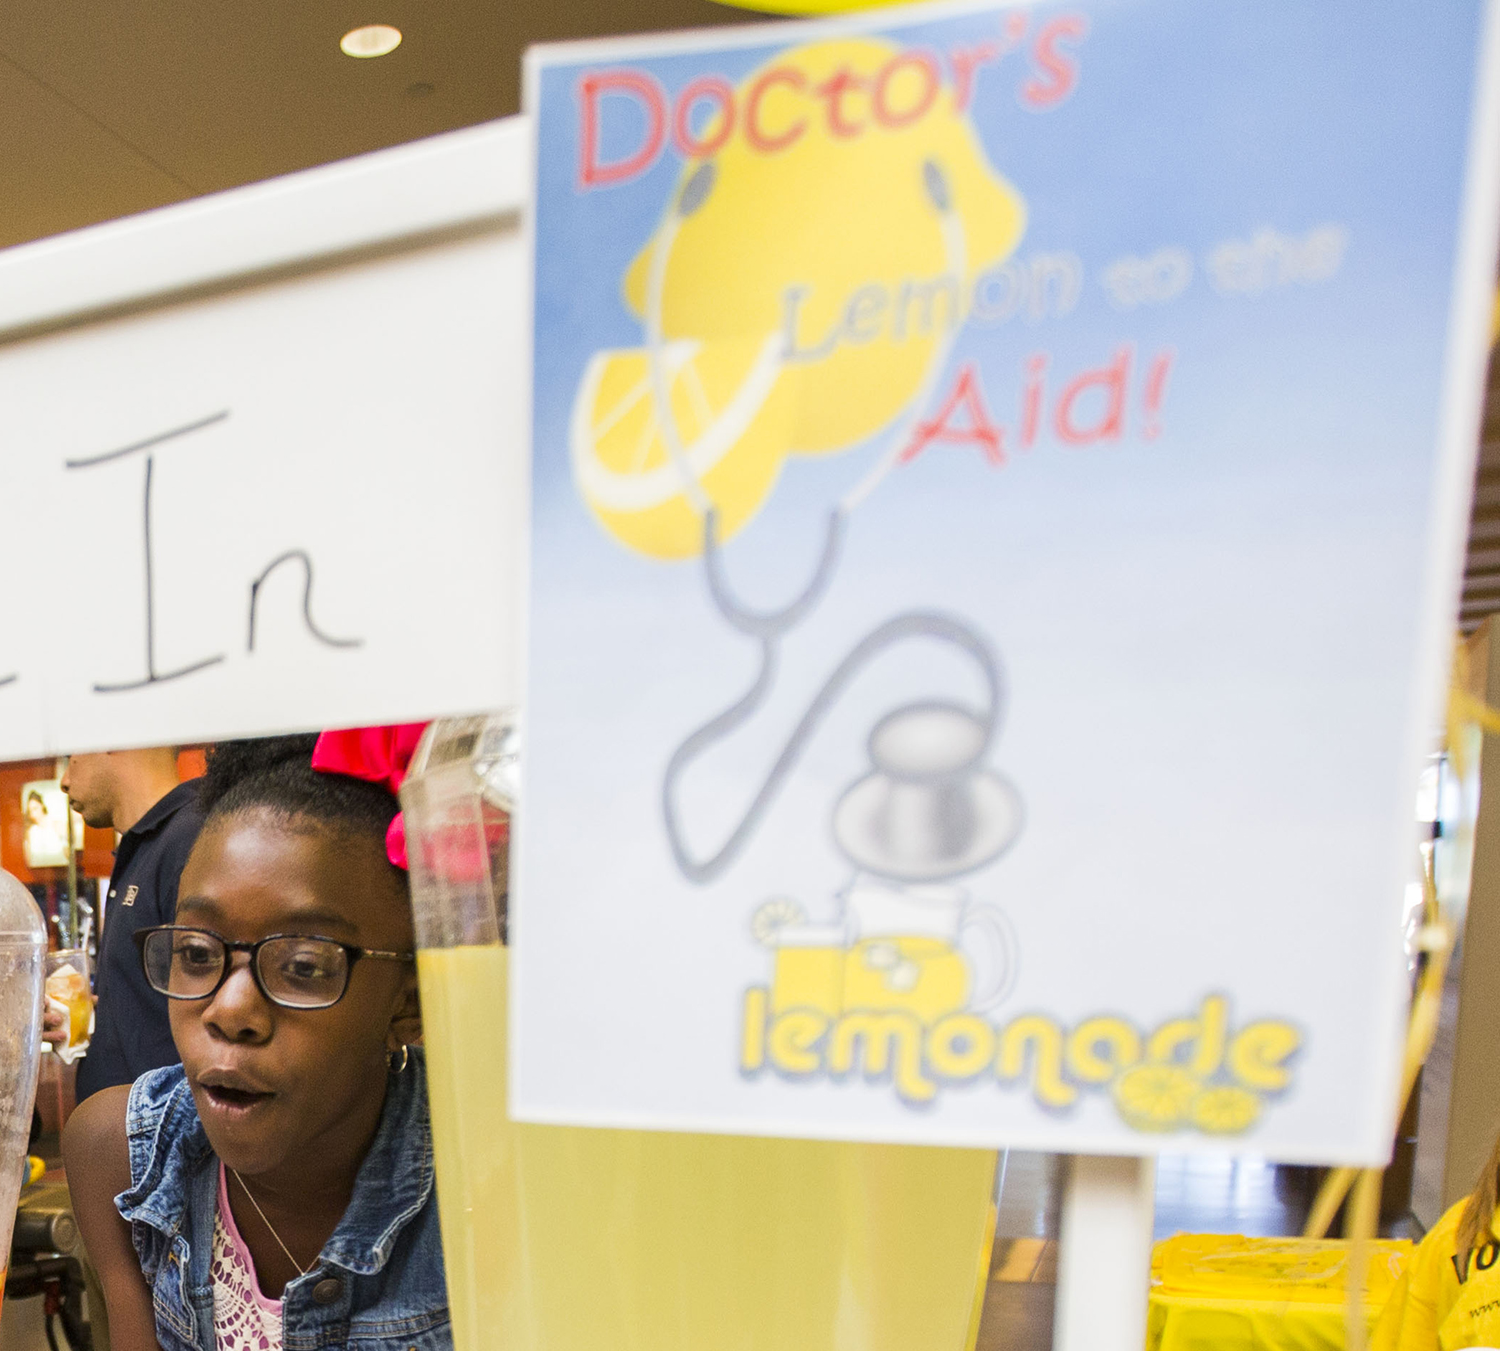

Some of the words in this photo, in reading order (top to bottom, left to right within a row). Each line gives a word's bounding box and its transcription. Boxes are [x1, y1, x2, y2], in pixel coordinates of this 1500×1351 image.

[576, 10, 1090, 194] Doctor's
[778, 250, 1084, 363] Lemon
[896, 341, 1177, 468] Aid!
[64, 409, 364, 693] In
[738, 985, 1304, 1112] lemonade
